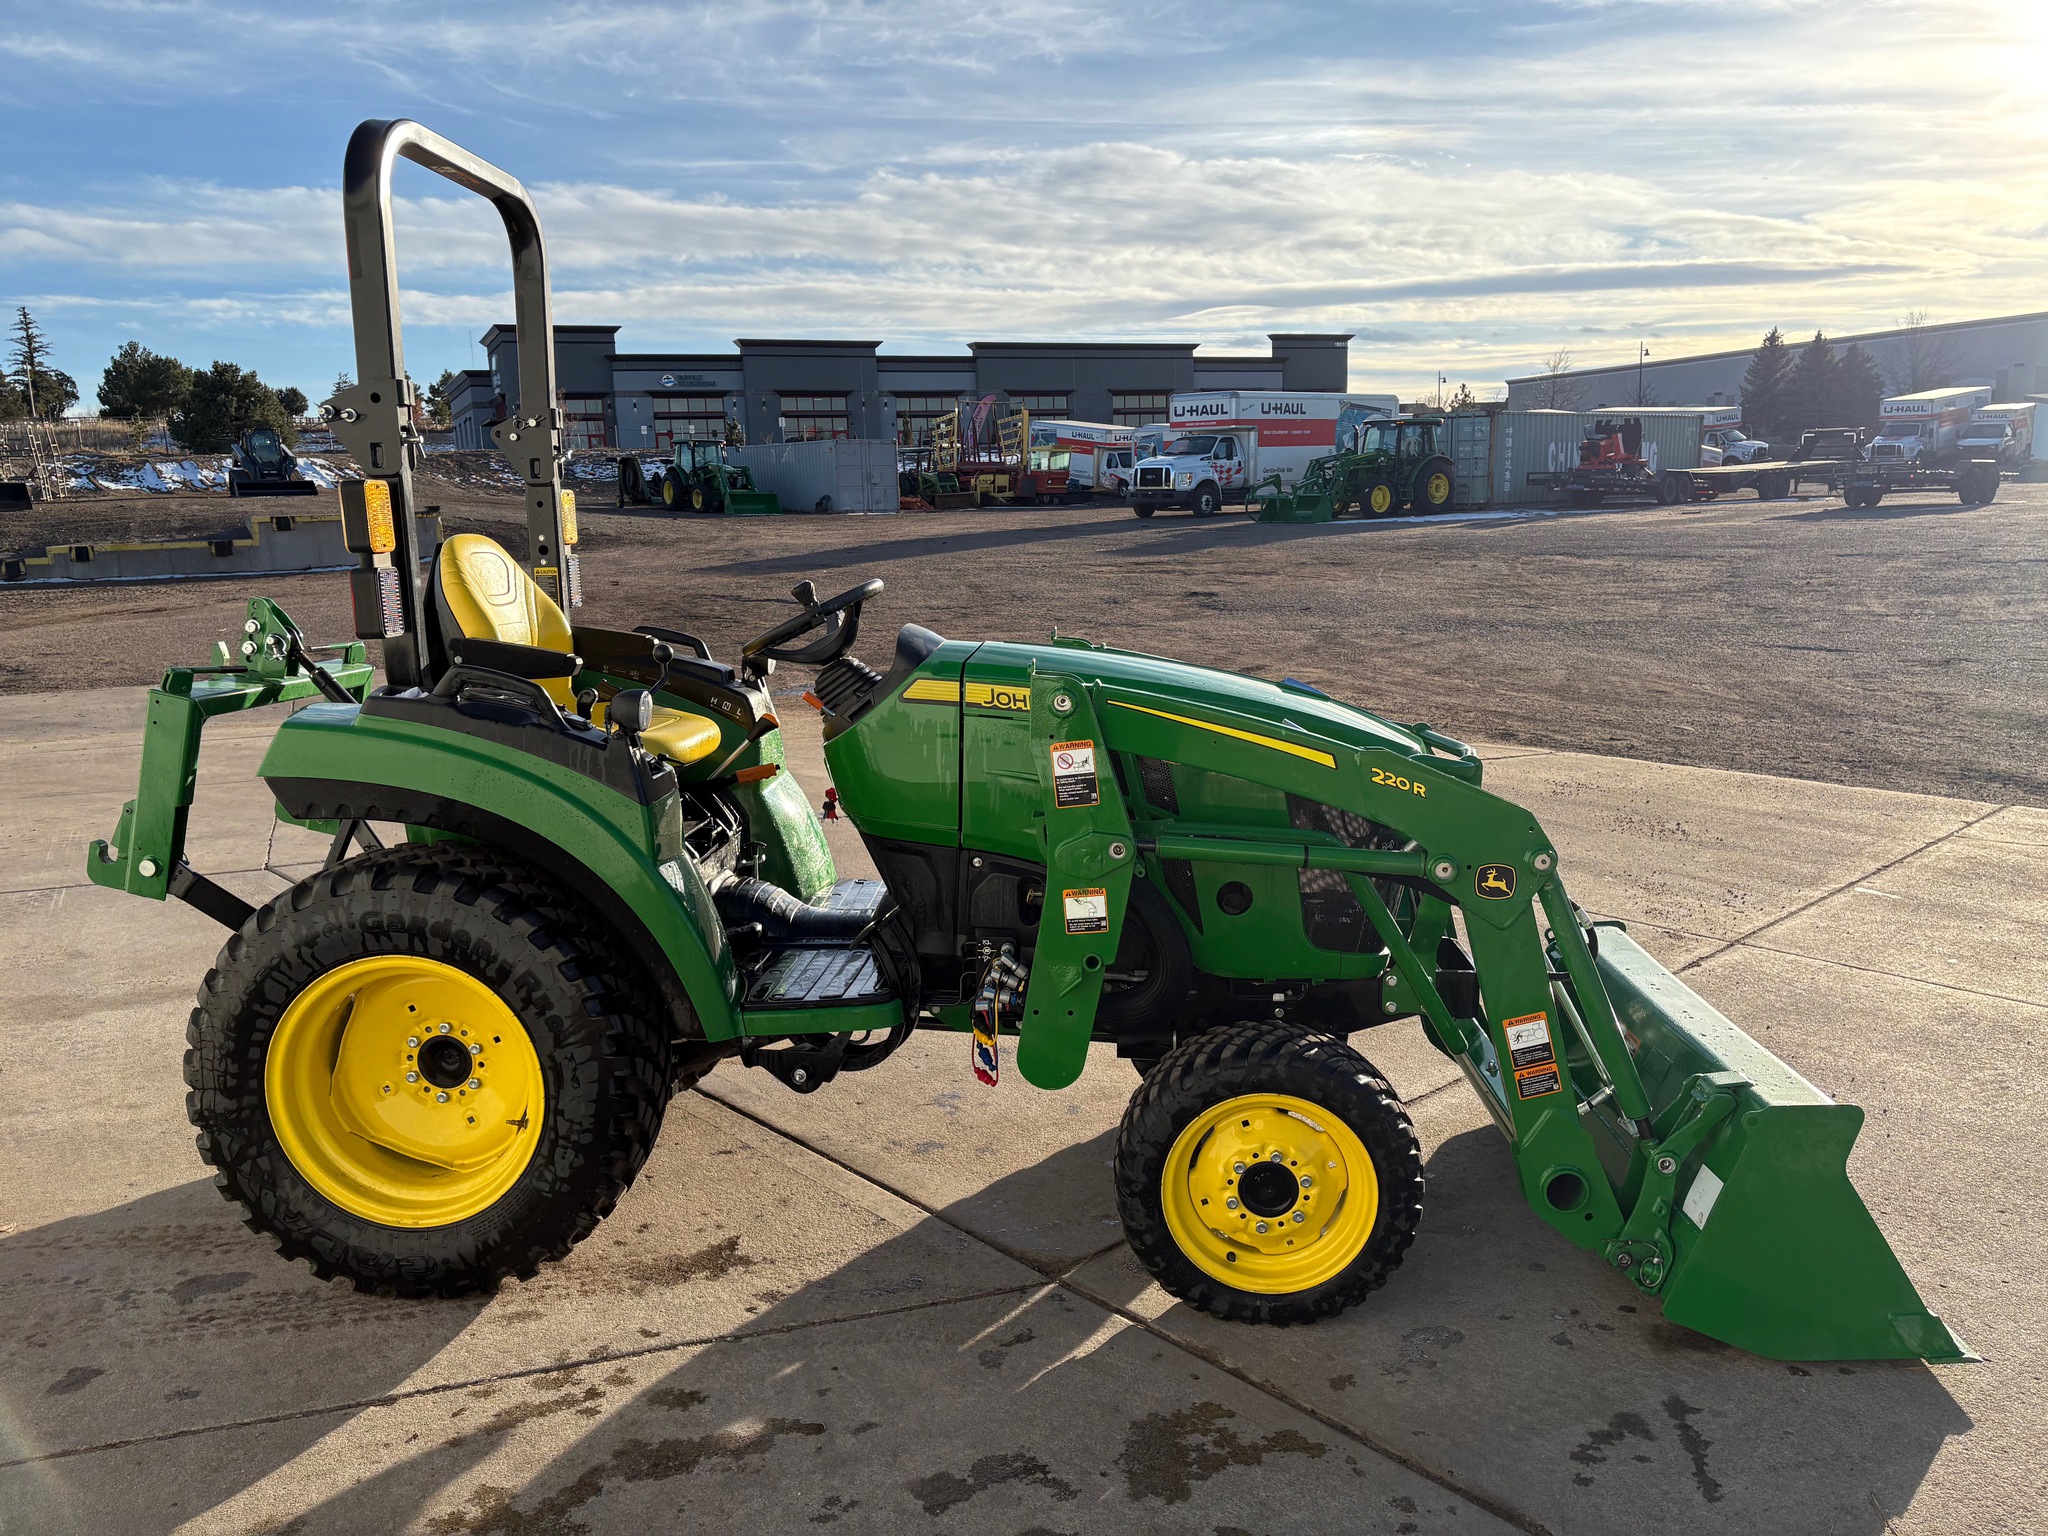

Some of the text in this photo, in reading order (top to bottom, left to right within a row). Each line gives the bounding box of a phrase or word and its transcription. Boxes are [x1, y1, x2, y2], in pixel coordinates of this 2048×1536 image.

[1174, 403, 1228, 417] U-HAUL
[1261, 402, 1307, 415] U-HAUL
[1884, 404, 1928, 414] U-HAUL
[1716, 413, 1739, 422] U-HAUL
[1071, 431, 1094, 440] U-HAUL
[1114, 434, 1133, 442] U-HA
[1548, 441, 1582, 472] CHIN
[983, 687, 1031, 709] JOH
[710, 696, 718, 705] H
[736, 707, 742, 716] L
[1059, 740, 1092, 750] WARNING
[1371, 767, 1427, 798] 220 R
[1071, 888, 1104, 896] WARNING
[1514, 1013, 1541, 1024] WARNING
[1526, 1066, 1553, 1076] WARNING
